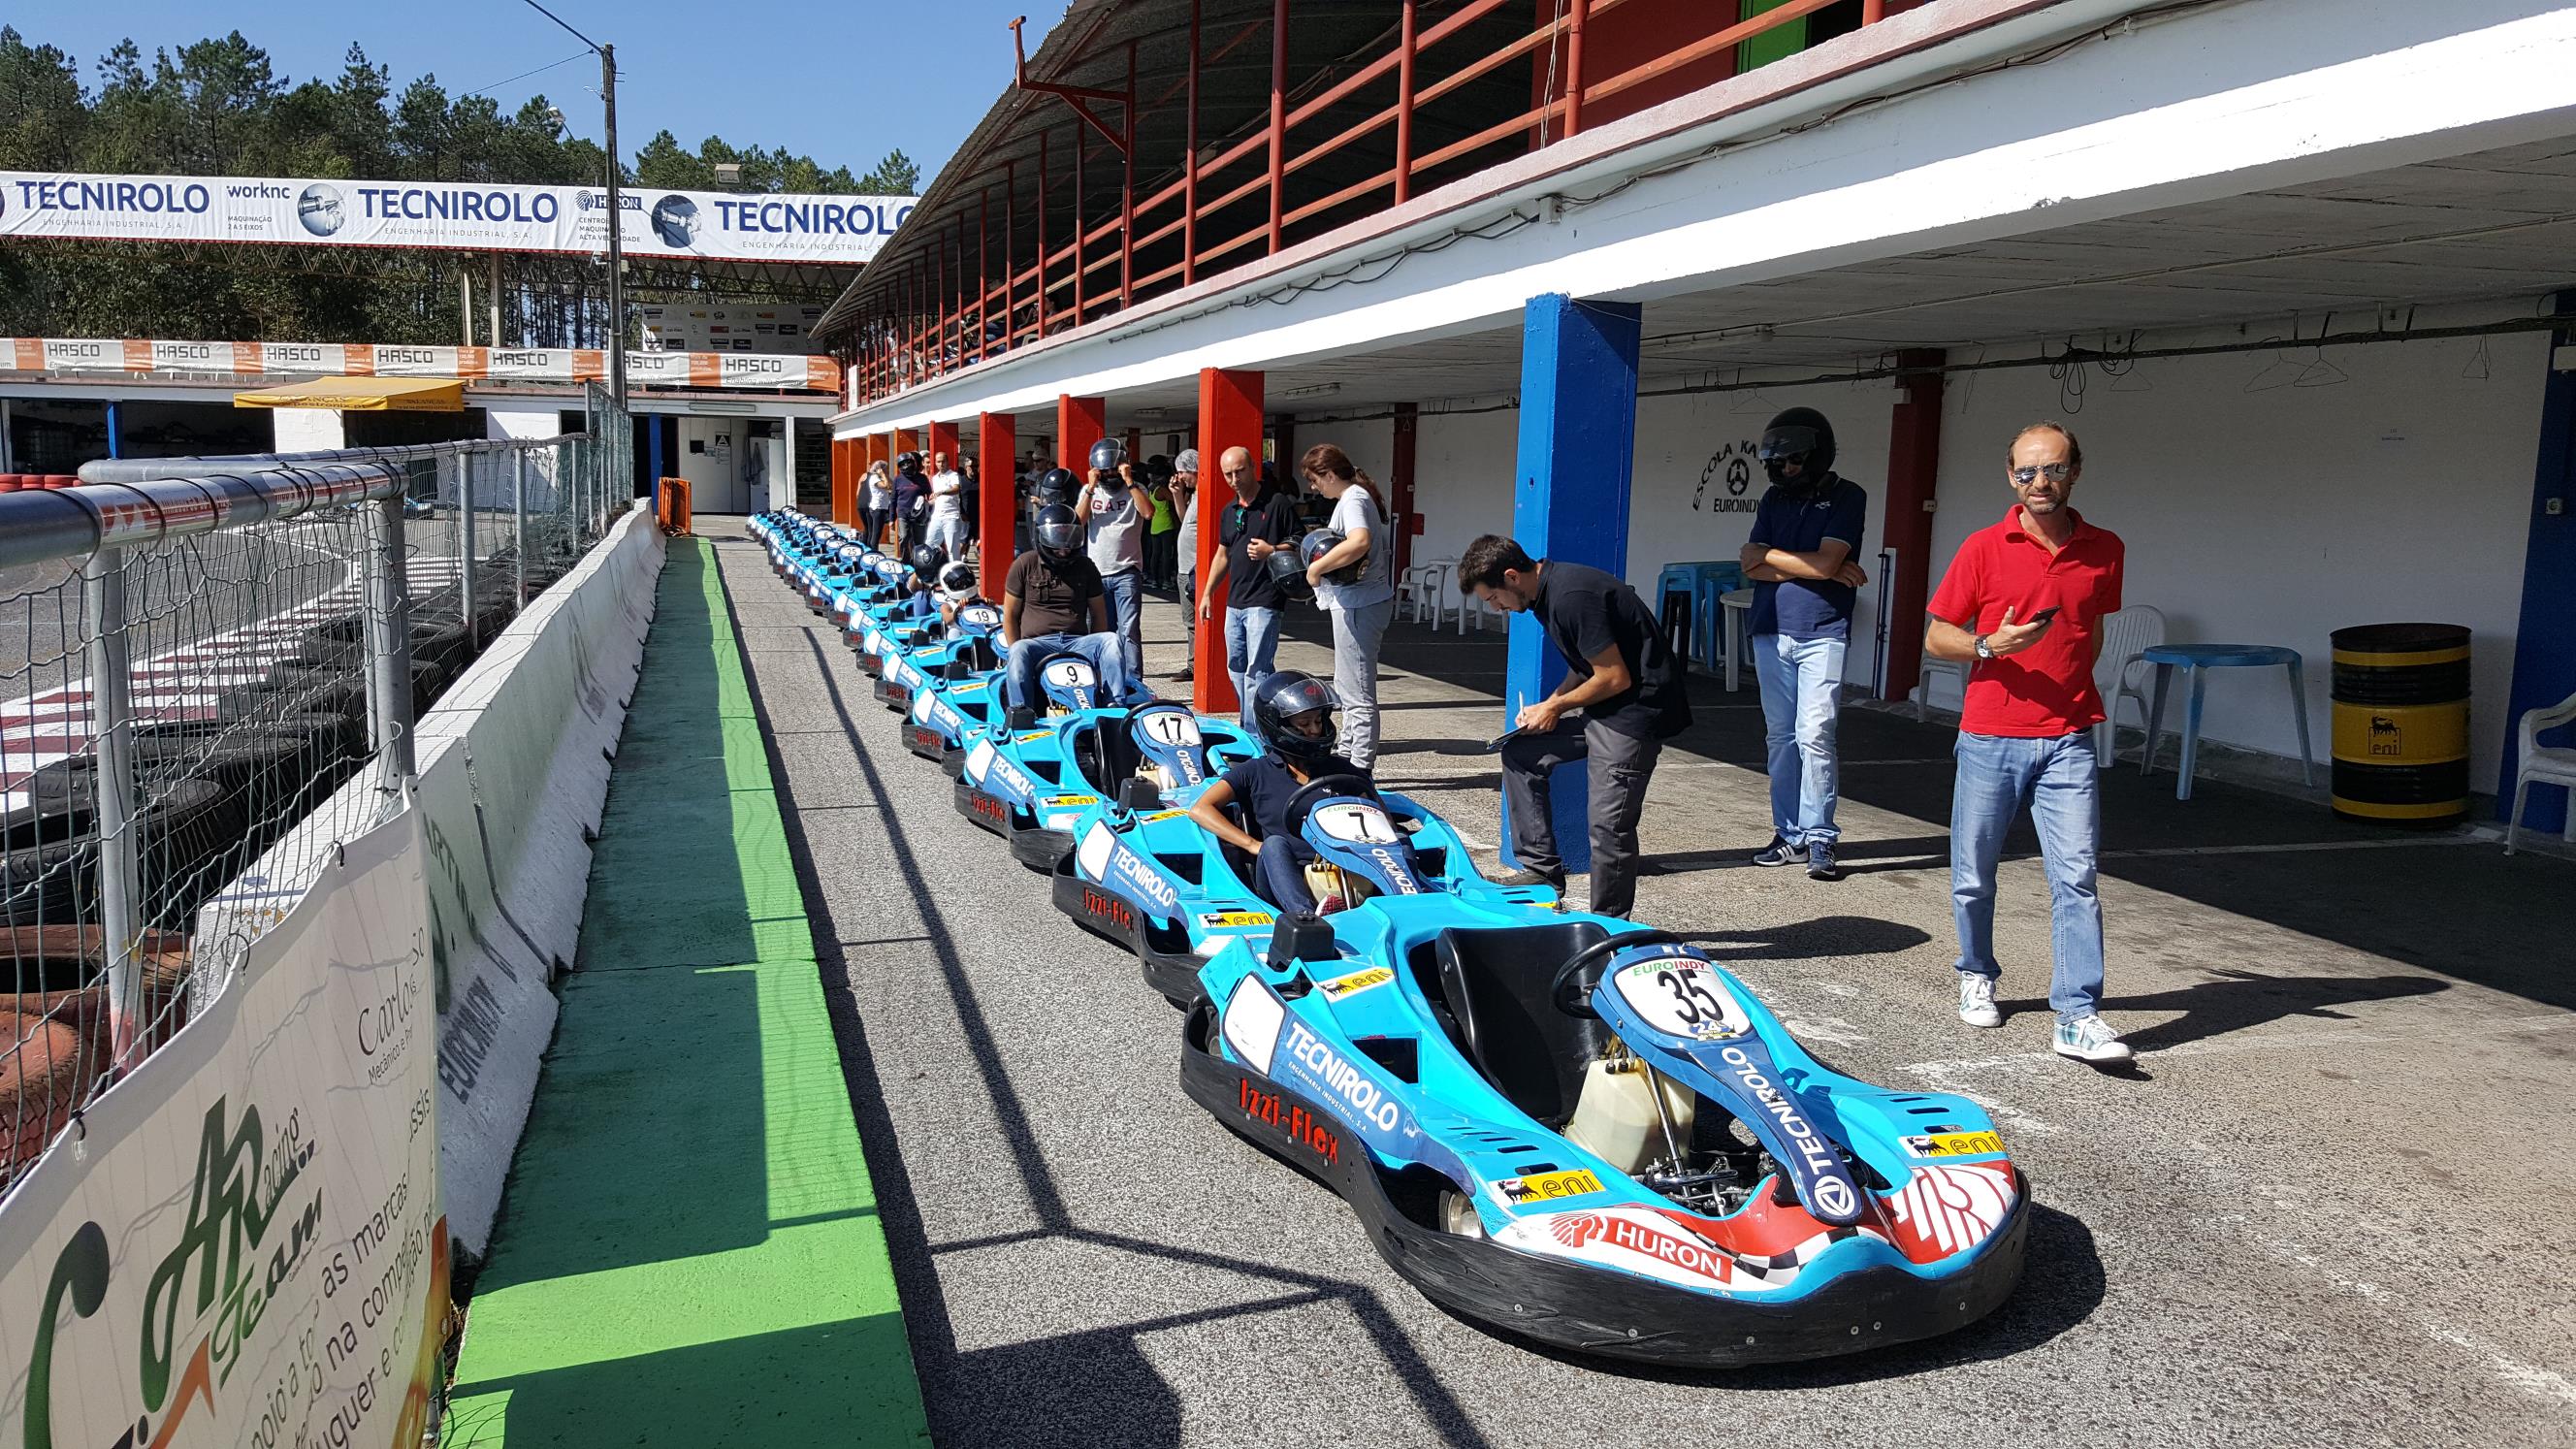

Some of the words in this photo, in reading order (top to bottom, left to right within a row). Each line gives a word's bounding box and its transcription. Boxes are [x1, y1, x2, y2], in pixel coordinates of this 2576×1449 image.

[16, 180, 209, 213] TECNIROLO
[226, 182, 290, 200] worknc
[358, 188, 559, 223] TECNIROLO
[598, 196, 639, 209] HON
[43, 218, 101, 227] ENGENHARIA
[227, 215, 273, 224] MAQUINAÇÃO
[385, 227, 444, 236] ENGENHARIA
[743, 241, 805, 250] ENGENHARIA
[48, 343, 101, 357] HASCO
[156, 344, 210, 359] HASCO
[267, 347, 321, 361] HASCO
[378, 349, 434, 363] HASCO
[492, 352, 548, 366] HASCO
[625, 355, 664, 370] ASCO
[725, 358, 782, 372] HASCO
[1692, 442, 1733, 512] ESCOLA
[1092, 499, 1127, 512] GAP
[975, 610, 989, 623] 19
[1066, 665, 1079, 683] 9
[1158, 717, 1182, 740] 17
[2371, 739, 2399, 756] eni
[1327, 805, 1379, 815] EUROINDY
[1347, 812, 1369, 839] 7
[1112, 844, 1175, 908] TECNIROLO
[1371, 848, 1419, 896] ECNIROLO
[1233, 915, 1272, 926] eni
[1632, 960, 1706, 977] EUROINDY
[1352, 971, 1393, 987] eni
[1657, 968, 1724, 1024] 35
[1285, 1021, 1399, 1132] TECNIROLO
[1721, 1046, 1833, 1176] TECNIROLO
[1240, 1077, 1337, 1165] Izzi-Flex
[1949, 1136, 2006, 1155] eni
[1541, 1175, 1599, 1198] eni
[322, 1251, 349, 1300] as
[352, 1172, 408, 1265] marcas
[1615, 1221, 1722, 1278] HURON
[326, 1321, 358, 1371] na
